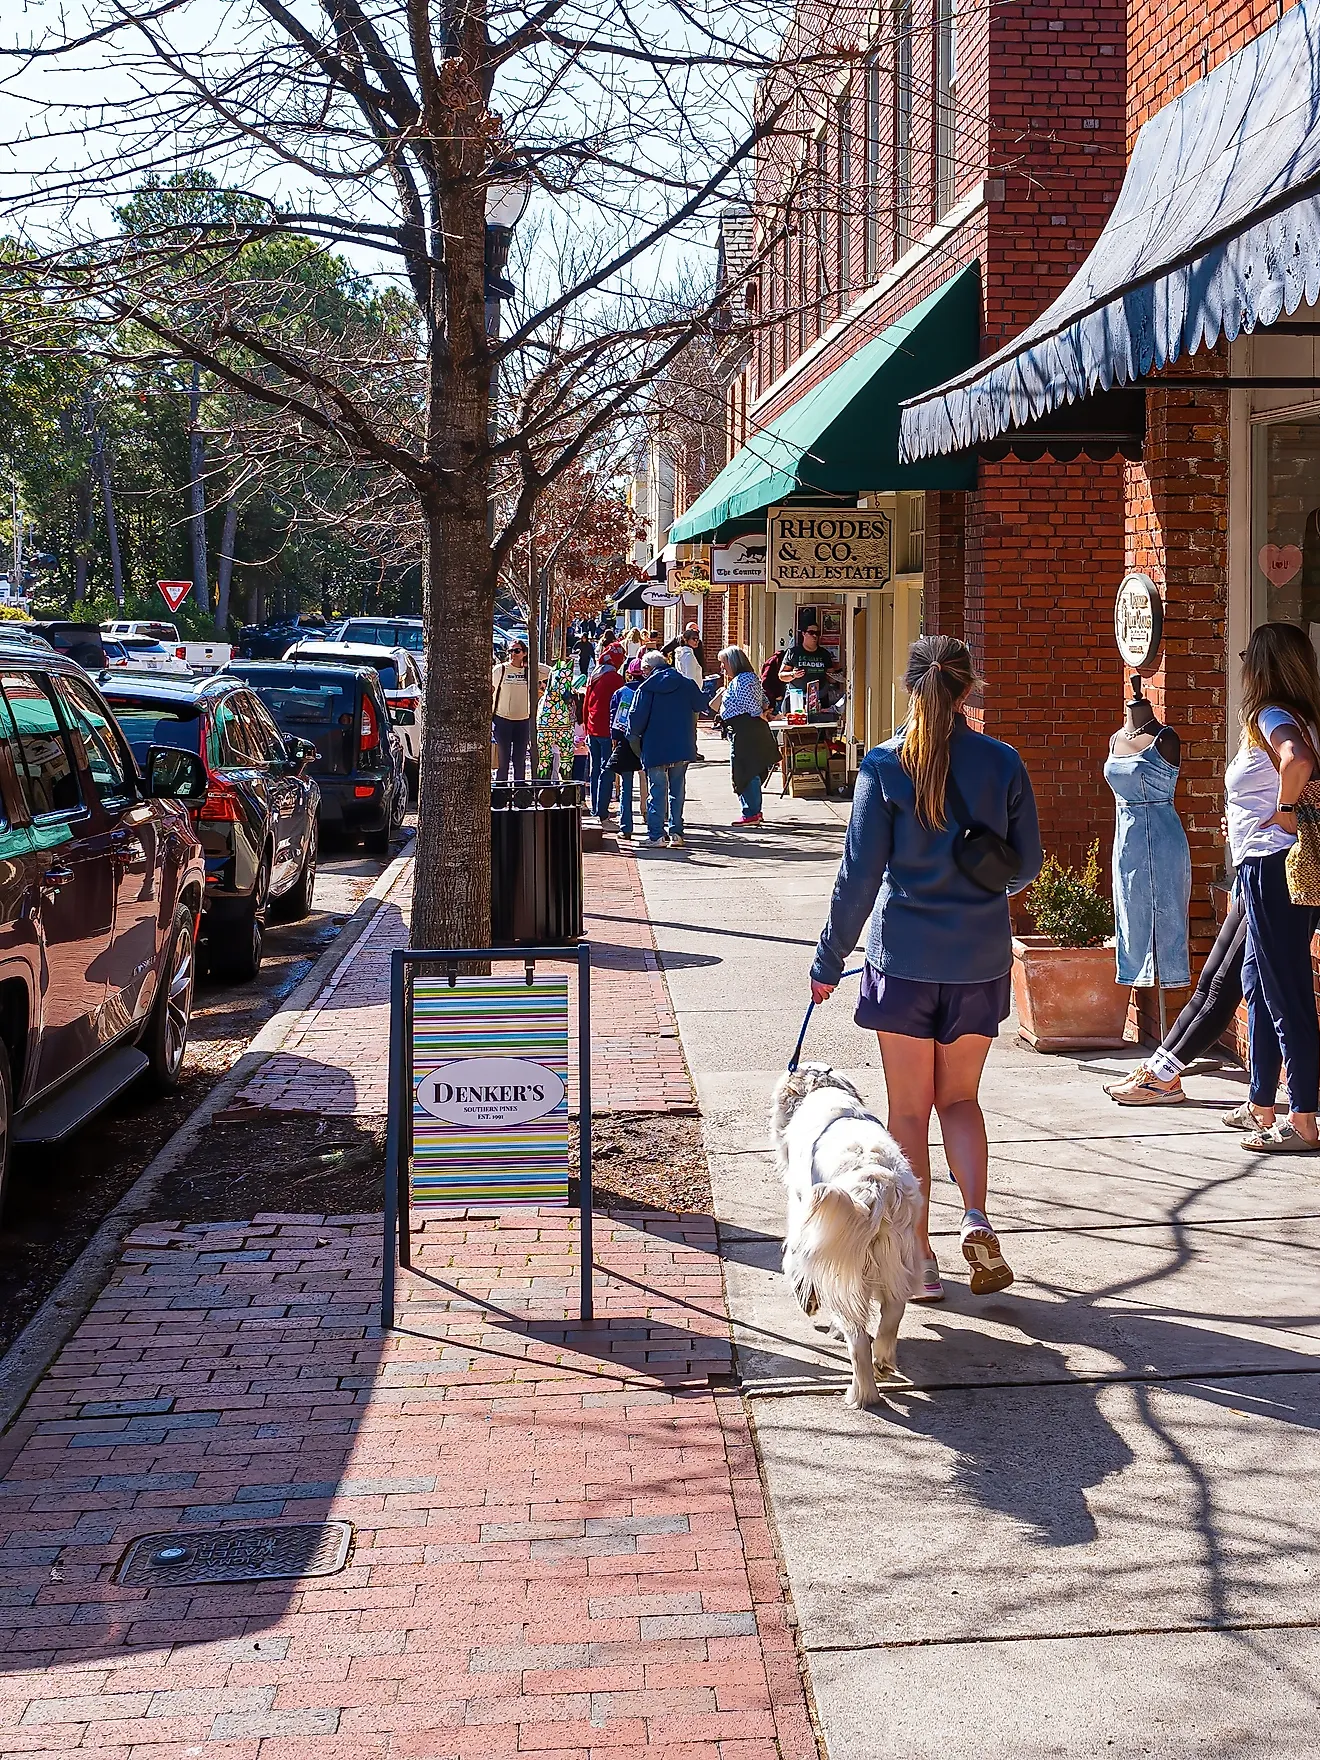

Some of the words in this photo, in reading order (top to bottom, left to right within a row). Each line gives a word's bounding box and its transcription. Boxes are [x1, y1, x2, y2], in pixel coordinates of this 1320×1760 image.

[778, 520, 885, 539] RHODES
[778, 542, 801, 561] &
[814, 542, 858, 562] CO.
[716, 568, 731, 576] The
[732, 568, 762, 576] Country
[777, 566, 821, 579] REAL
[824, 566, 883, 579] ESTATE
[433, 1082, 545, 1104] DENKER'S
[202, 1538, 276, 1550] METER
[199, 1547, 273, 1559] WATER
